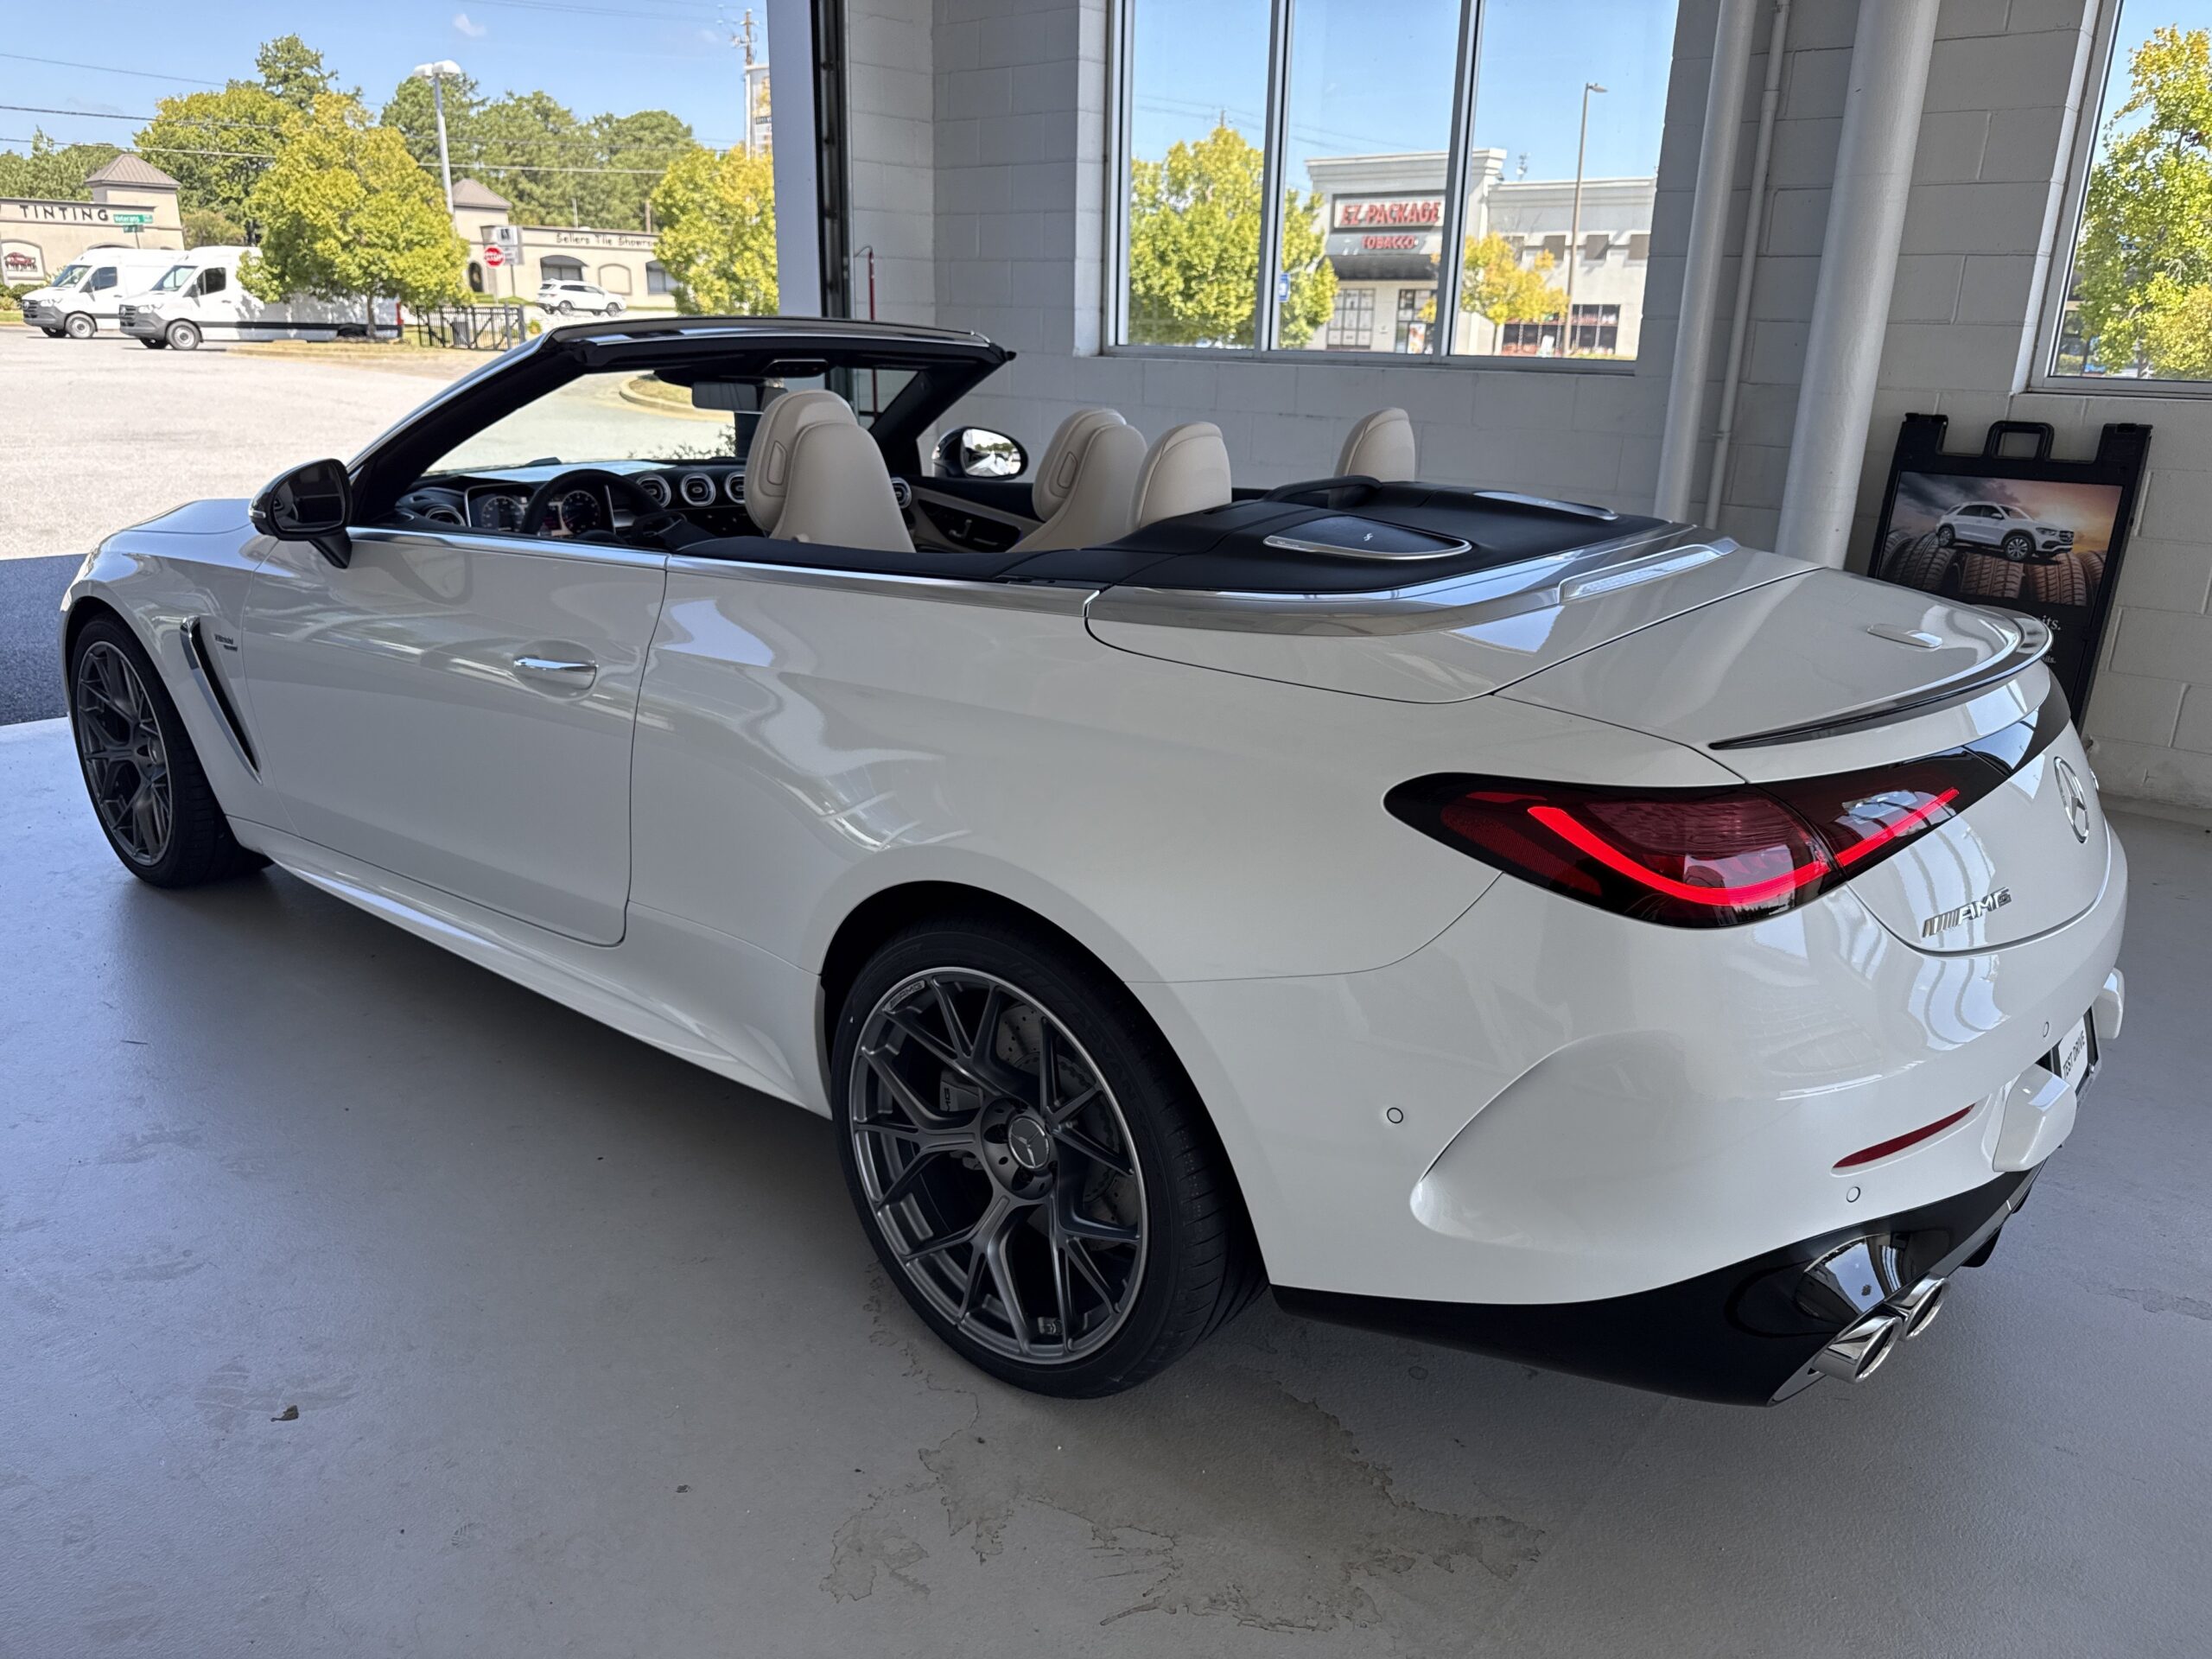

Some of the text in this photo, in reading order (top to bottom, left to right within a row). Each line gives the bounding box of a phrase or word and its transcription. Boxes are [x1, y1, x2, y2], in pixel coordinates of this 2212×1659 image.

[19, 204, 109, 221] TINTING
[1341, 202, 1441, 225] EZ PACKAGE
[1361, 235, 1416, 249] TOBACCO
[2063, 1030, 2085, 1079] TEST DRIVE
